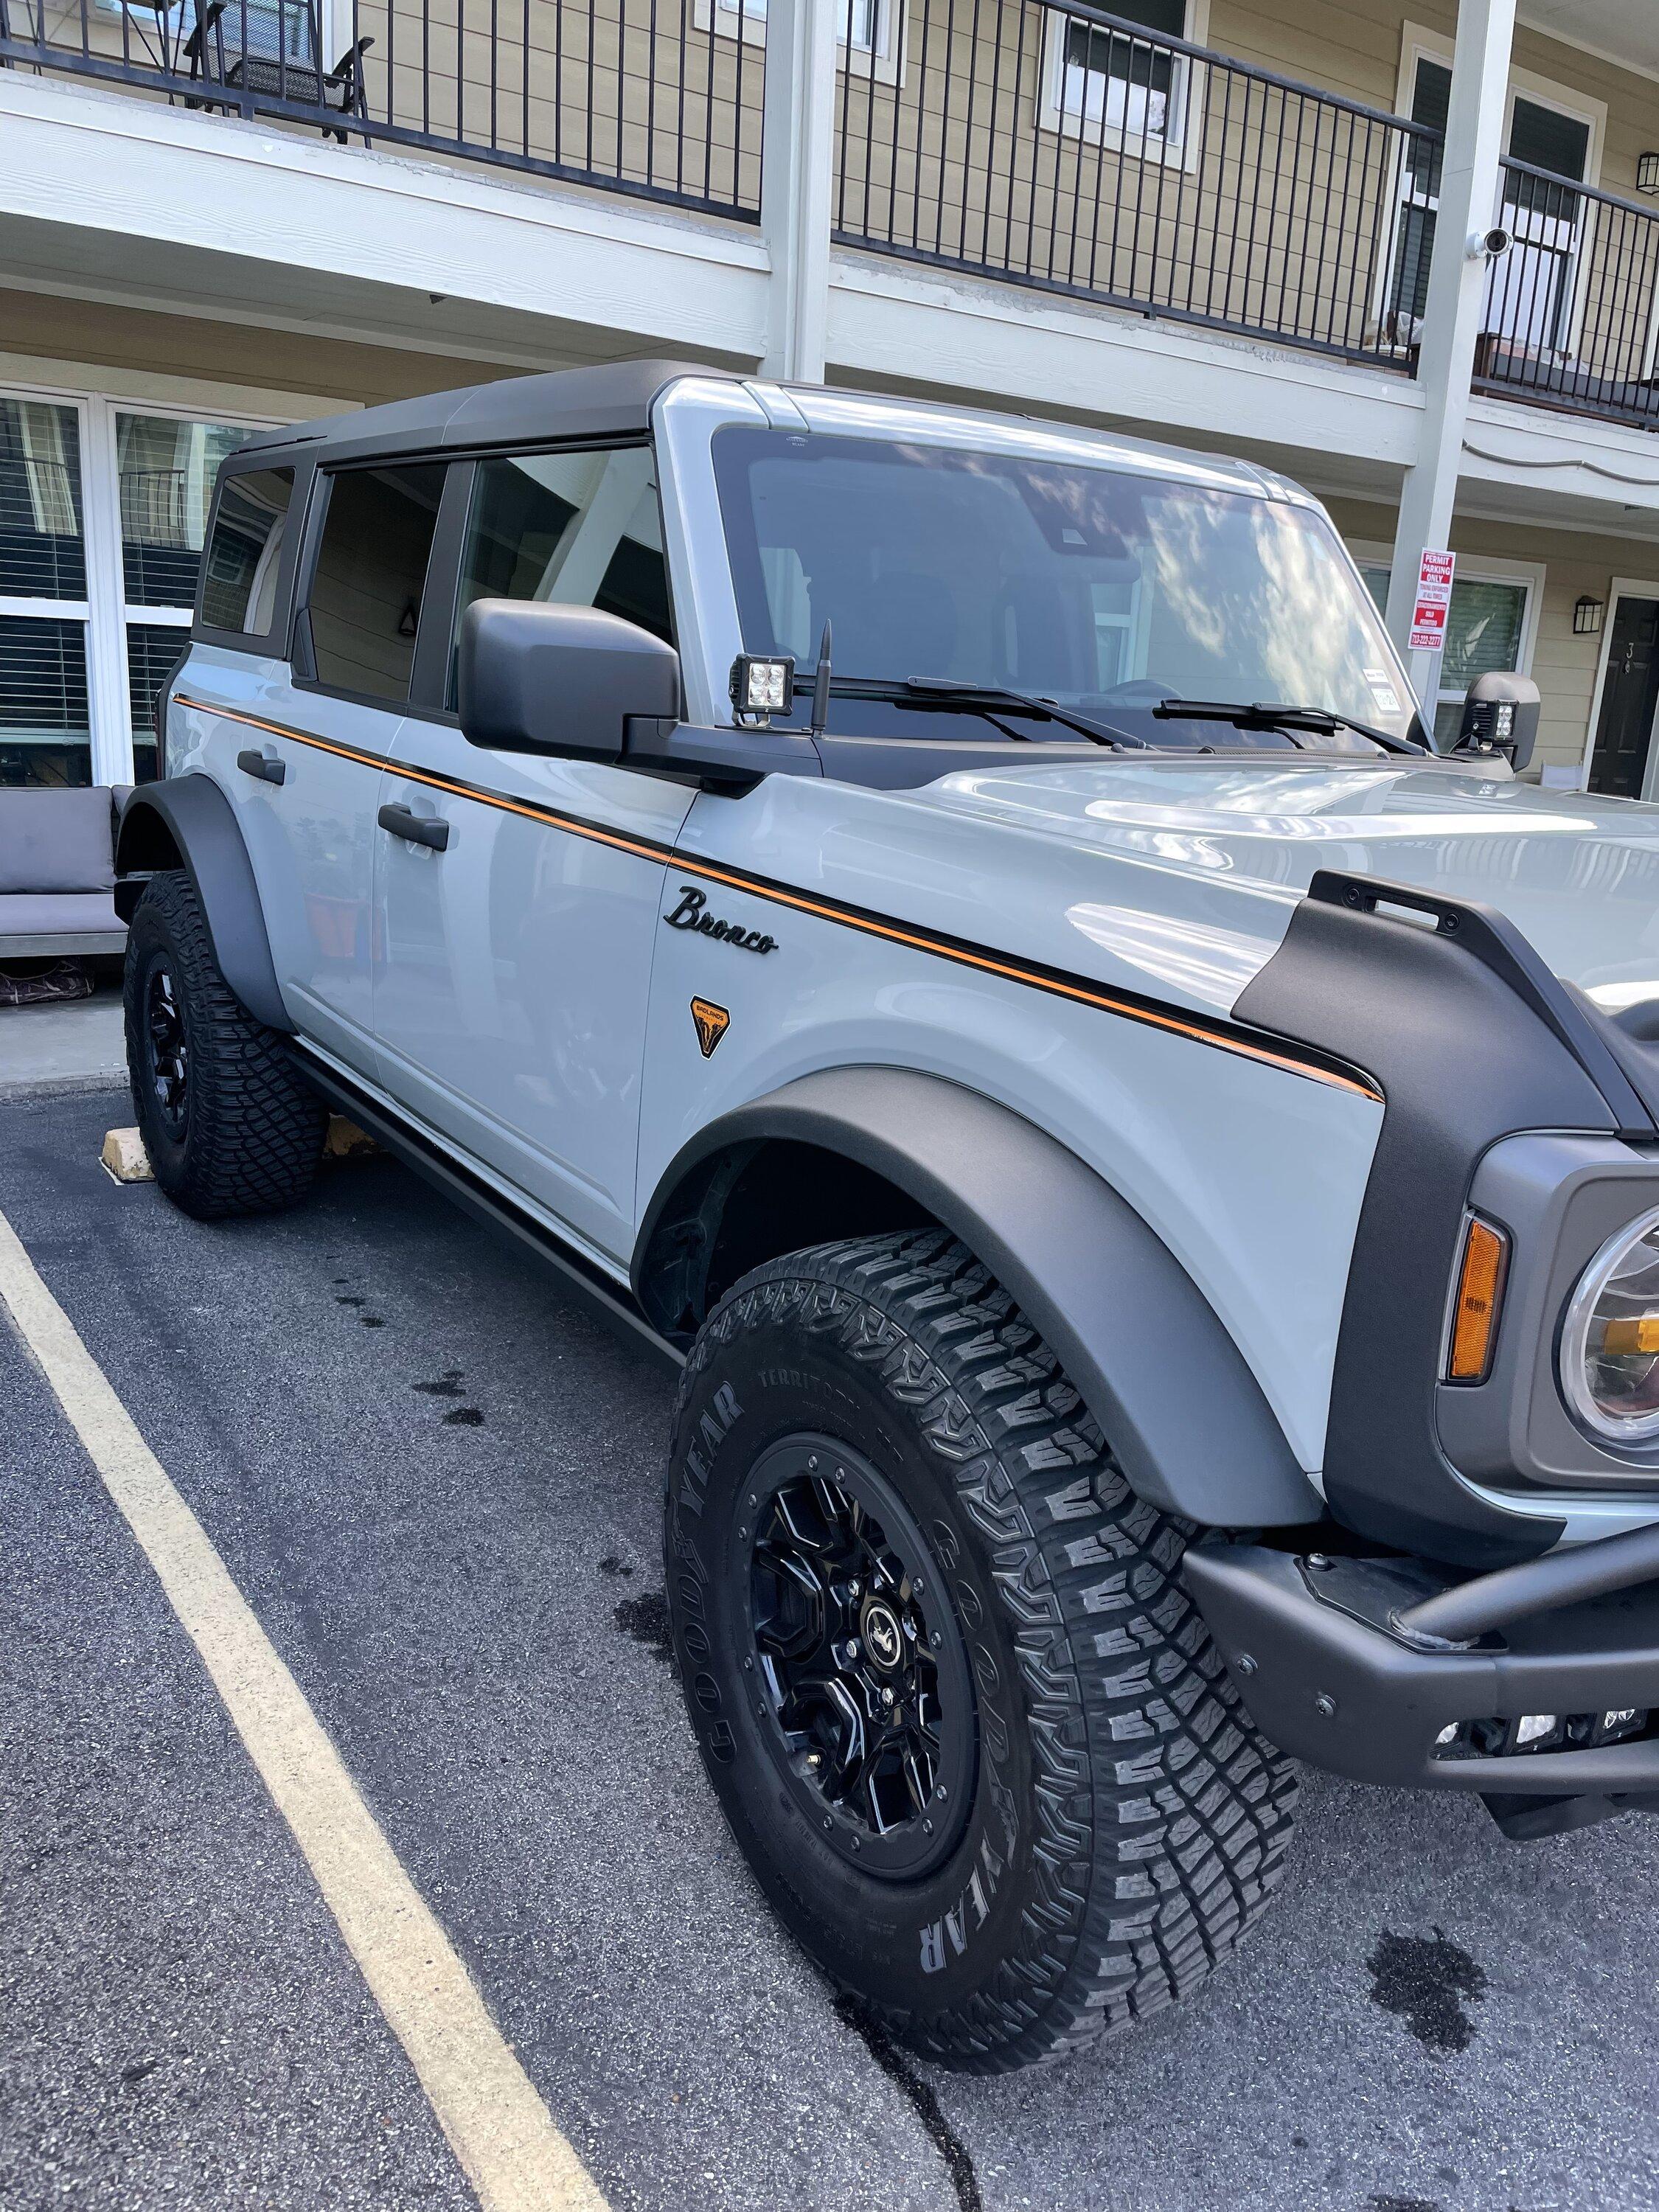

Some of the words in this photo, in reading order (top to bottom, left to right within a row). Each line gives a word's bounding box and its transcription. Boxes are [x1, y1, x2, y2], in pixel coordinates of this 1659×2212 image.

[1425, 554, 1450, 566] PERMIT
[1422, 563, 1450, 575] PARKING
[1427, 574, 1444, 583] ONLY
[1626, 642, 1634, 658] 3
[663, 886, 779, 954] Bronco
[696, 1004, 724, 1021] BADLANDS
